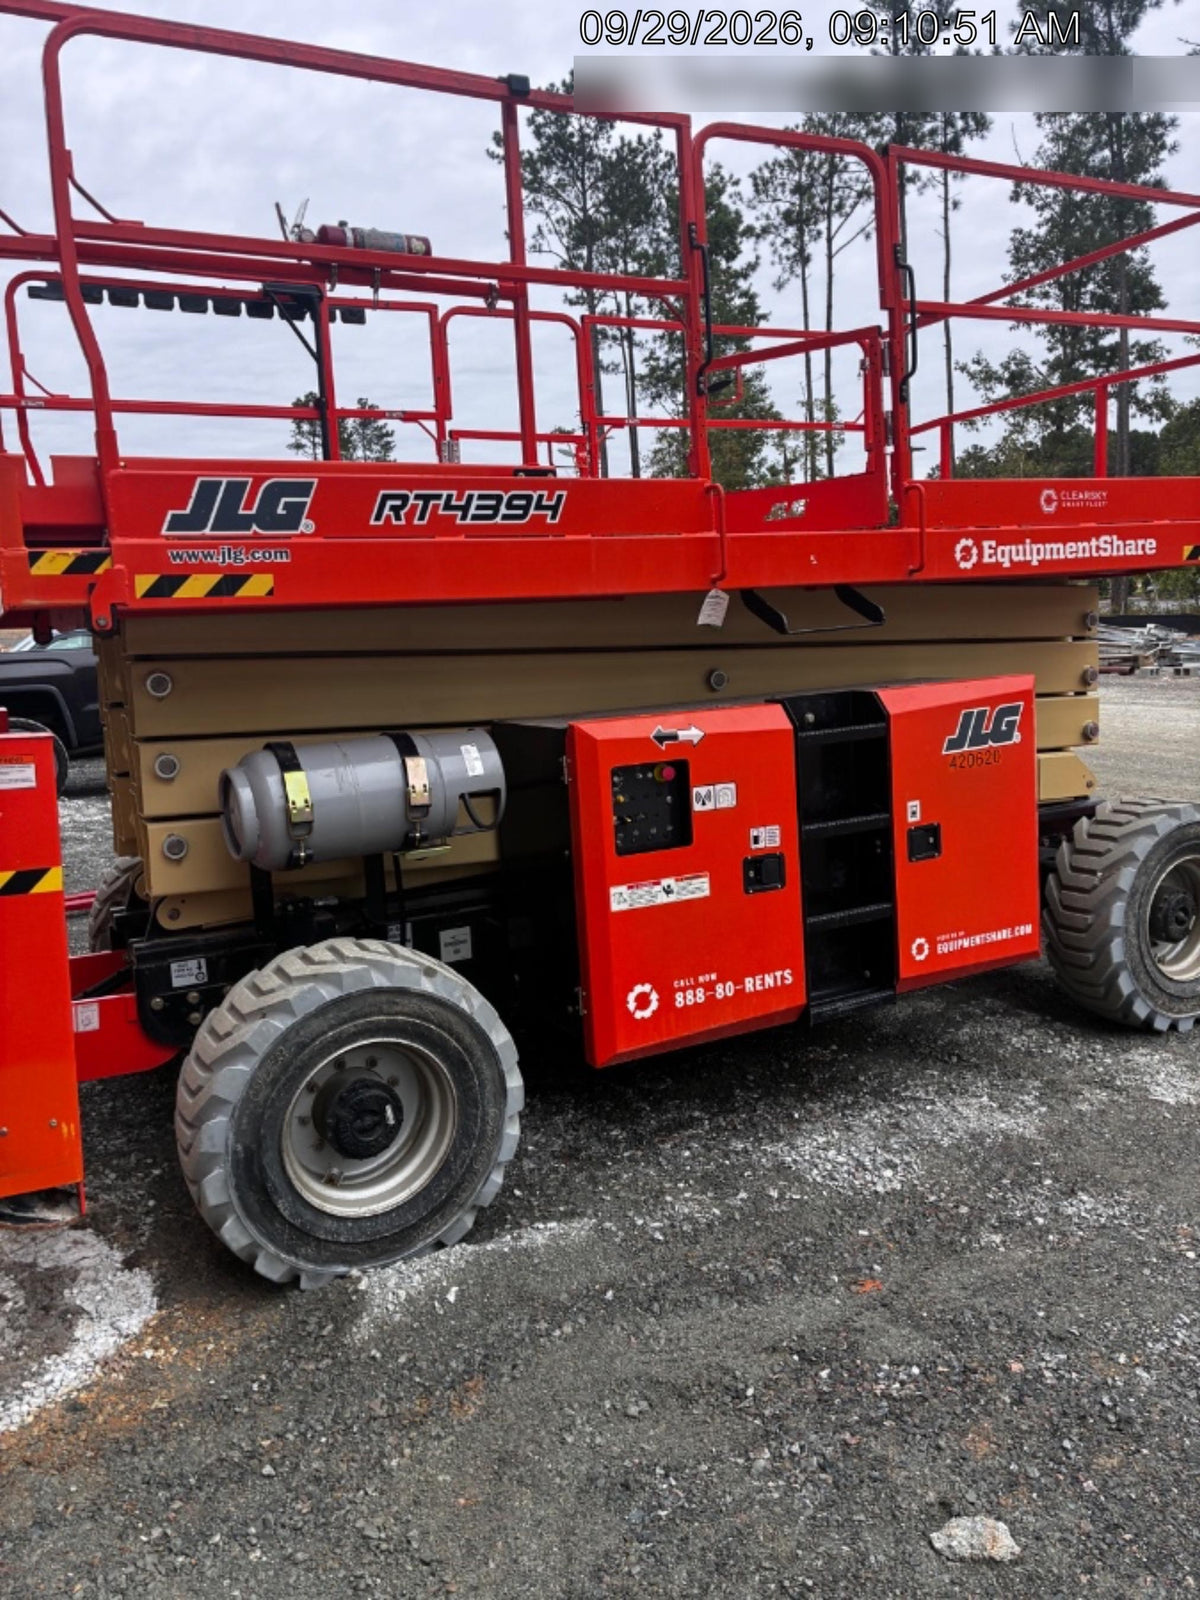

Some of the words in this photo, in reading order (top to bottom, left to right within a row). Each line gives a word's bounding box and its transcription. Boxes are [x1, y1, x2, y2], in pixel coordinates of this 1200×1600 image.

[369, 490, 568, 525] RT4394
[169, 545, 291, 565] www.jlg.com
[982, 535, 1157, 567] EquipmentShare
[949, 750, 999, 769] 420620
[937, 924, 1033, 954] EQUIPMENTSHARE.COM
[673, 977, 695, 989] CALL
[698, 972, 718, 984] NOW
[675, 968, 794, 1009] 888-80-RENTS
